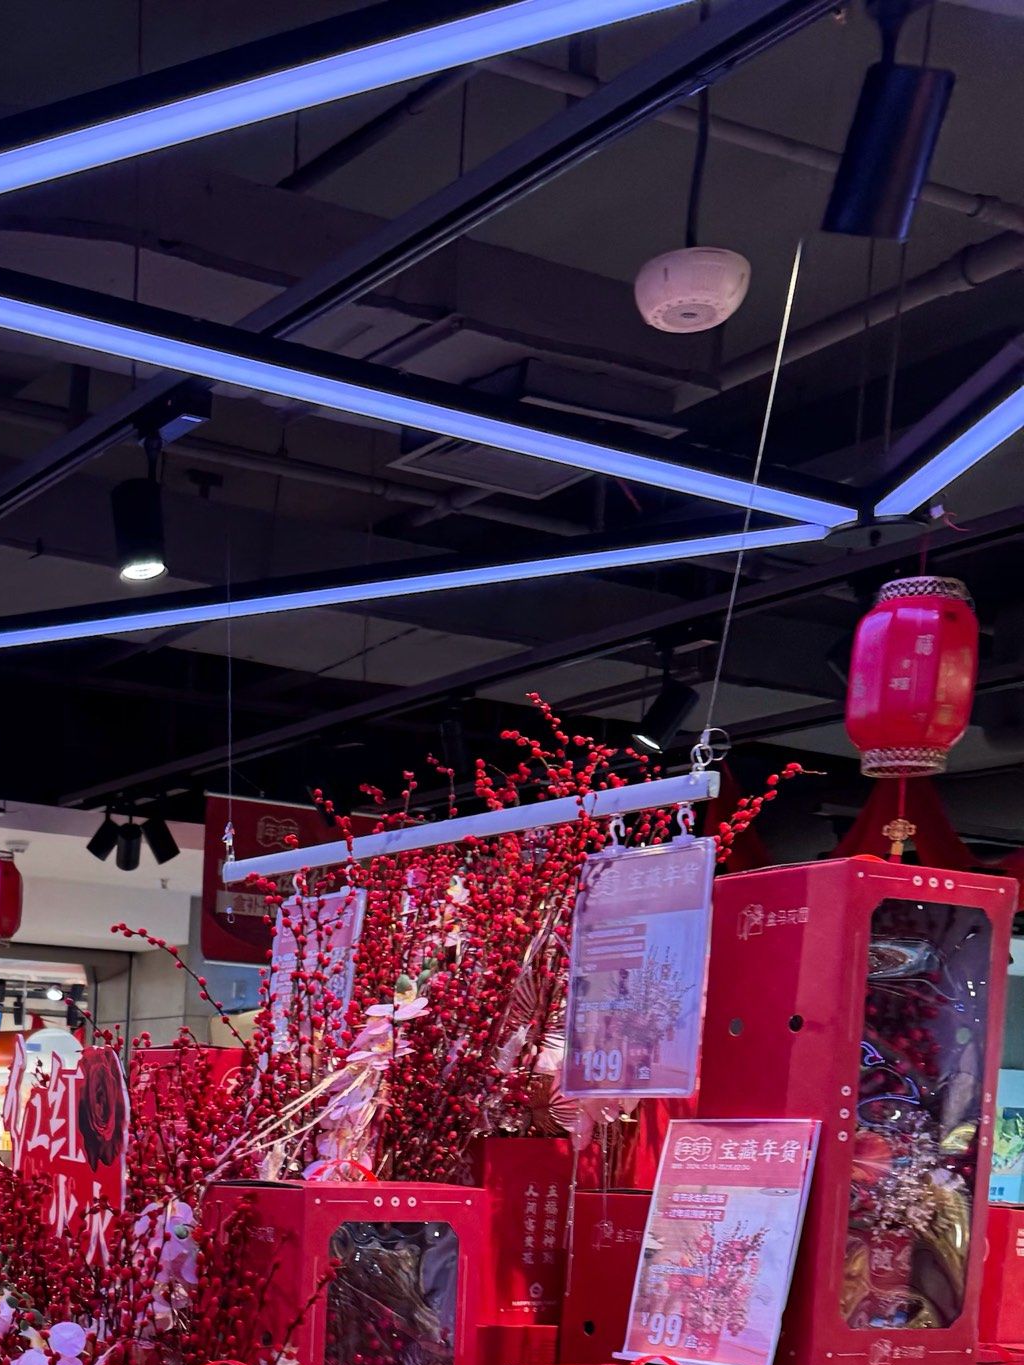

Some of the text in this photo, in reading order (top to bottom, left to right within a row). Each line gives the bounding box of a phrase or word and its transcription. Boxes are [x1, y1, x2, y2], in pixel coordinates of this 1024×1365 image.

[765, 906, 809, 927] 盒马花园
[717, 1138, 802, 1164] 宝藏年货
